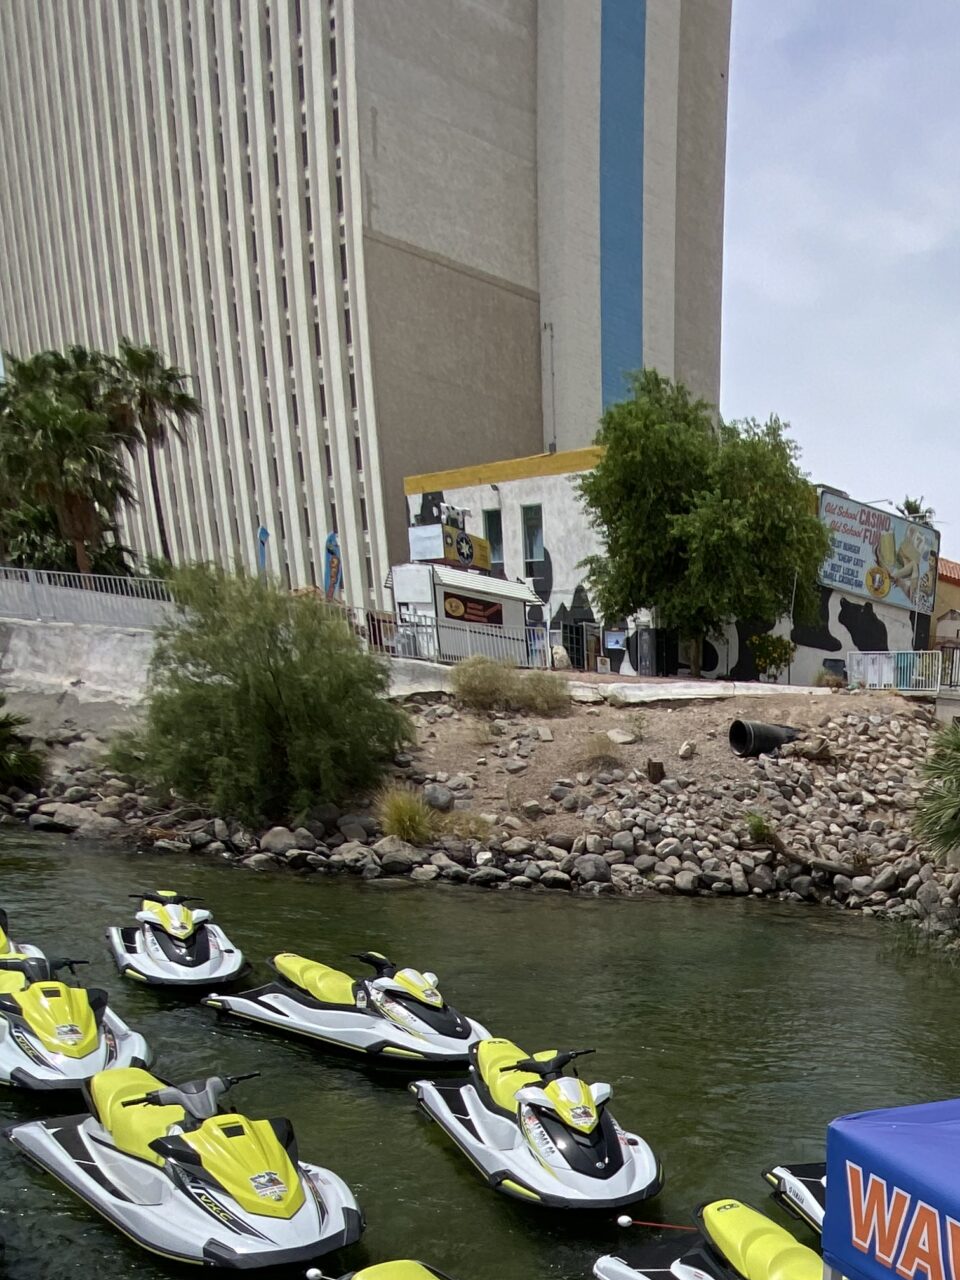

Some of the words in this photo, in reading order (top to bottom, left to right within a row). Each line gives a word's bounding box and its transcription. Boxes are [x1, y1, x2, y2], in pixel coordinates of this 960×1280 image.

[825, 502, 837, 515] Old
[837, 506, 859, 520] School
[859, 509, 891, 532] CASINO
[831, 520, 842, 532] Old
[842, 523, 864, 537] School
